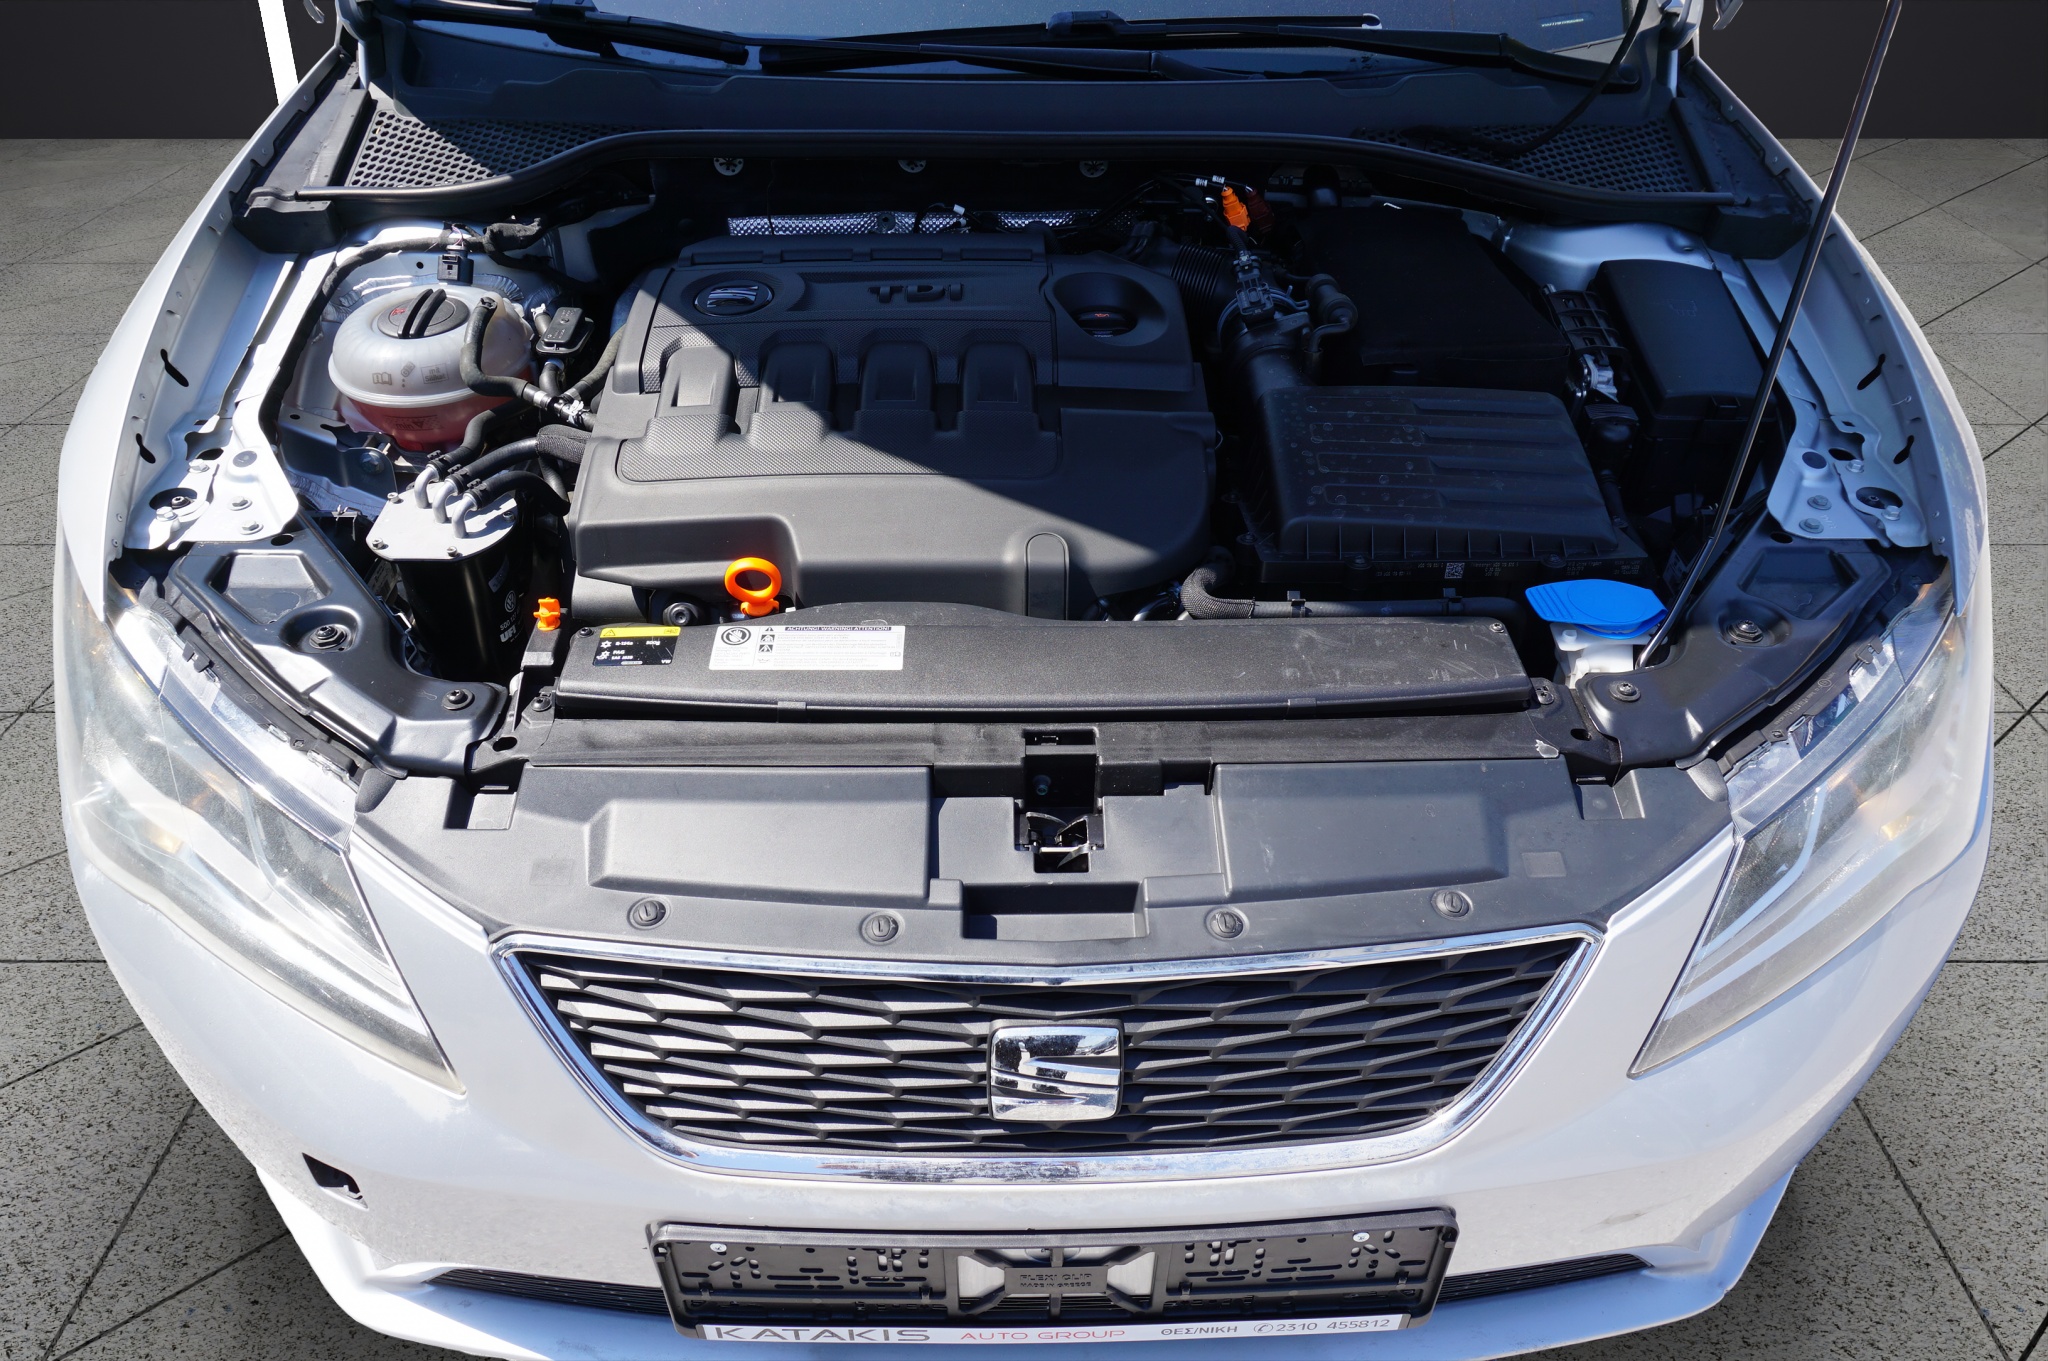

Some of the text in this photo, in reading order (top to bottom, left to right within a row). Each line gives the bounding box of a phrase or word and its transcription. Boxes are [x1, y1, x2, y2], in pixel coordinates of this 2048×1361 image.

[868, 283, 964, 303] TDI
[1020, 1272, 1093, 1281] FLEXI CLIP
[1276, 1319, 1390, 1333] 2310 455812
[715, 1327, 1126, 1342] KATAKIS AUTO GROUP
